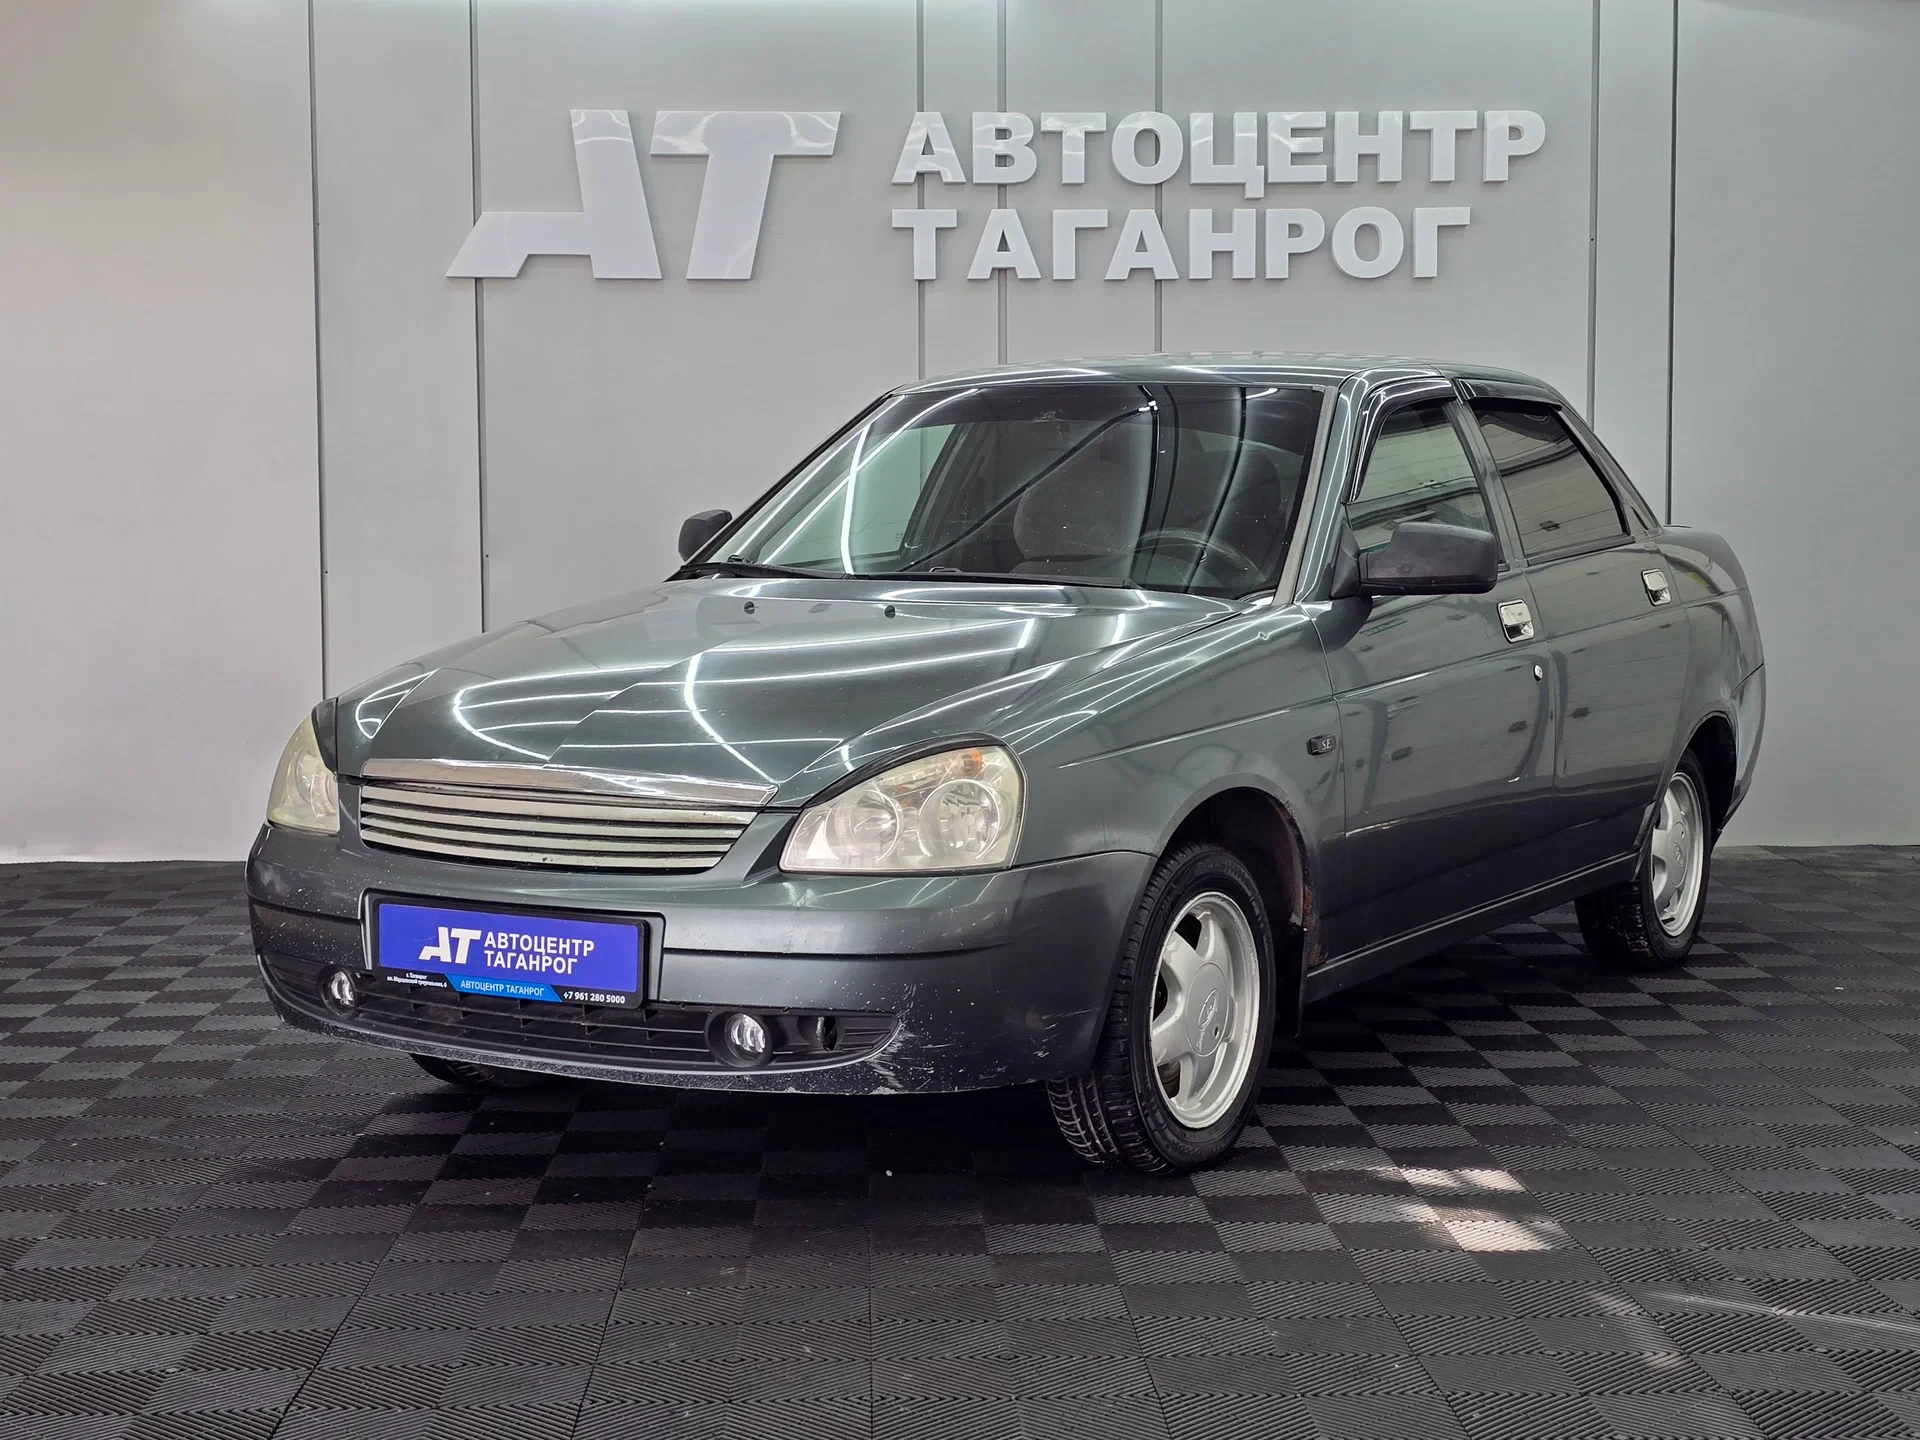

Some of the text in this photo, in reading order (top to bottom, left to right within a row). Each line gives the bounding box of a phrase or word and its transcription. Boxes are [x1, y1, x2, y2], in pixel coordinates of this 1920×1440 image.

[891, 110, 1546, 199] АВТОЦЕНТР
[891, 206, 1471, 280] ТАГАНРОГ
[1321, 738, 1332, 750] SE
[483, 931, 595, 957] АВТОЦЕНТР
[483, 950, 578, 975] ТАГАНРОГ
[460, 980, 545, 997] АВТОЦЕНТР ТАГАНРОГ
[563, 991, 626, 1004] +7 961 280 5000
